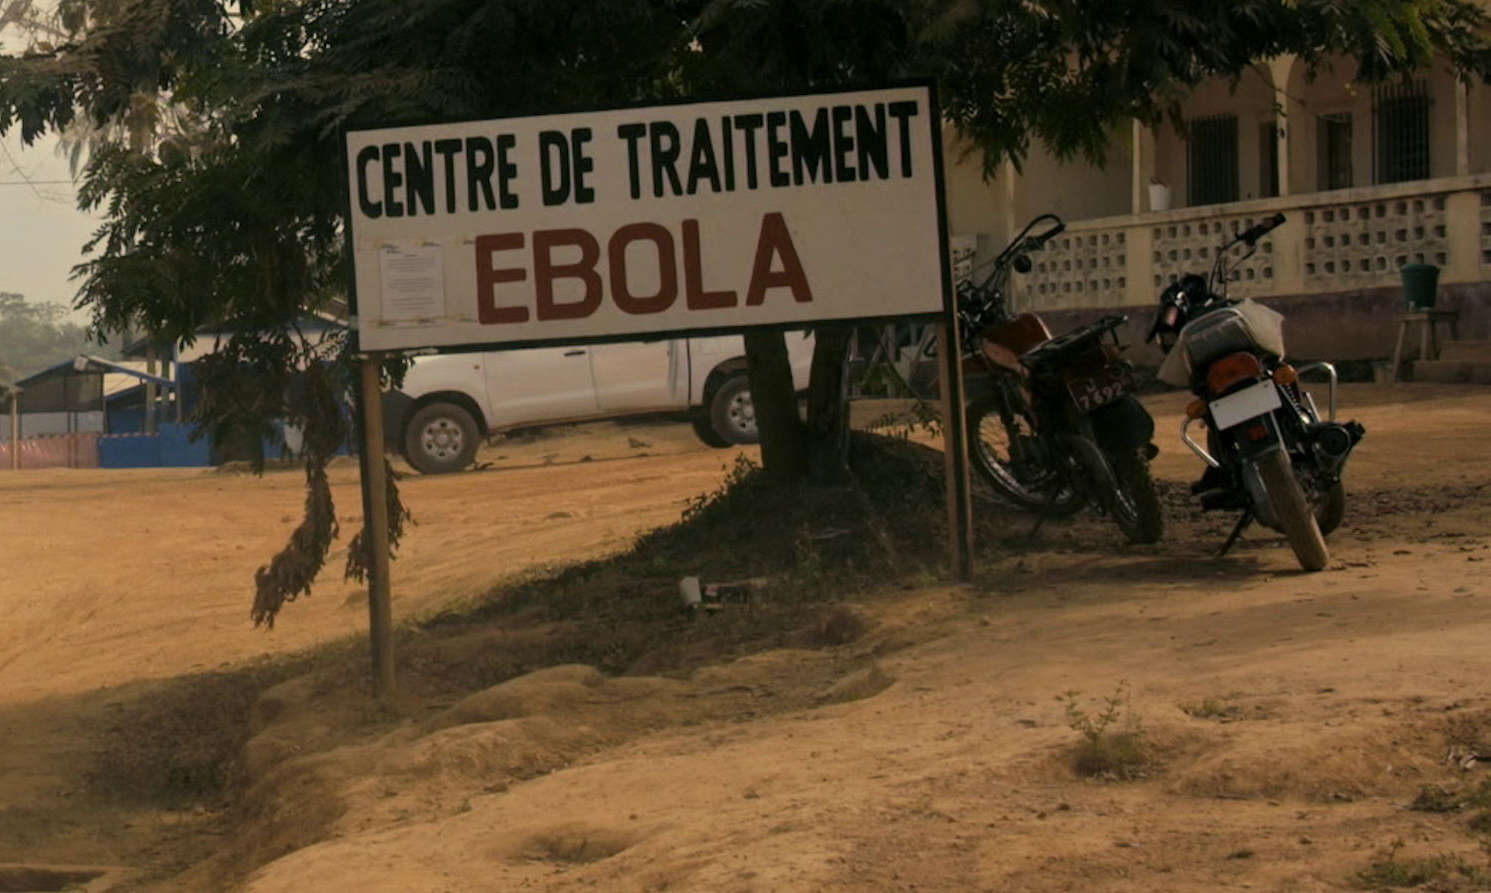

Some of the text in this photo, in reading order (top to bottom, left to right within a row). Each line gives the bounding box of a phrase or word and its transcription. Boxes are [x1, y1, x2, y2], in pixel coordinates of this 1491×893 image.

[356, 100, 920, 219] CENTRE DE TRAITEMENT
[474, 211, 814, 326] EBOLA
